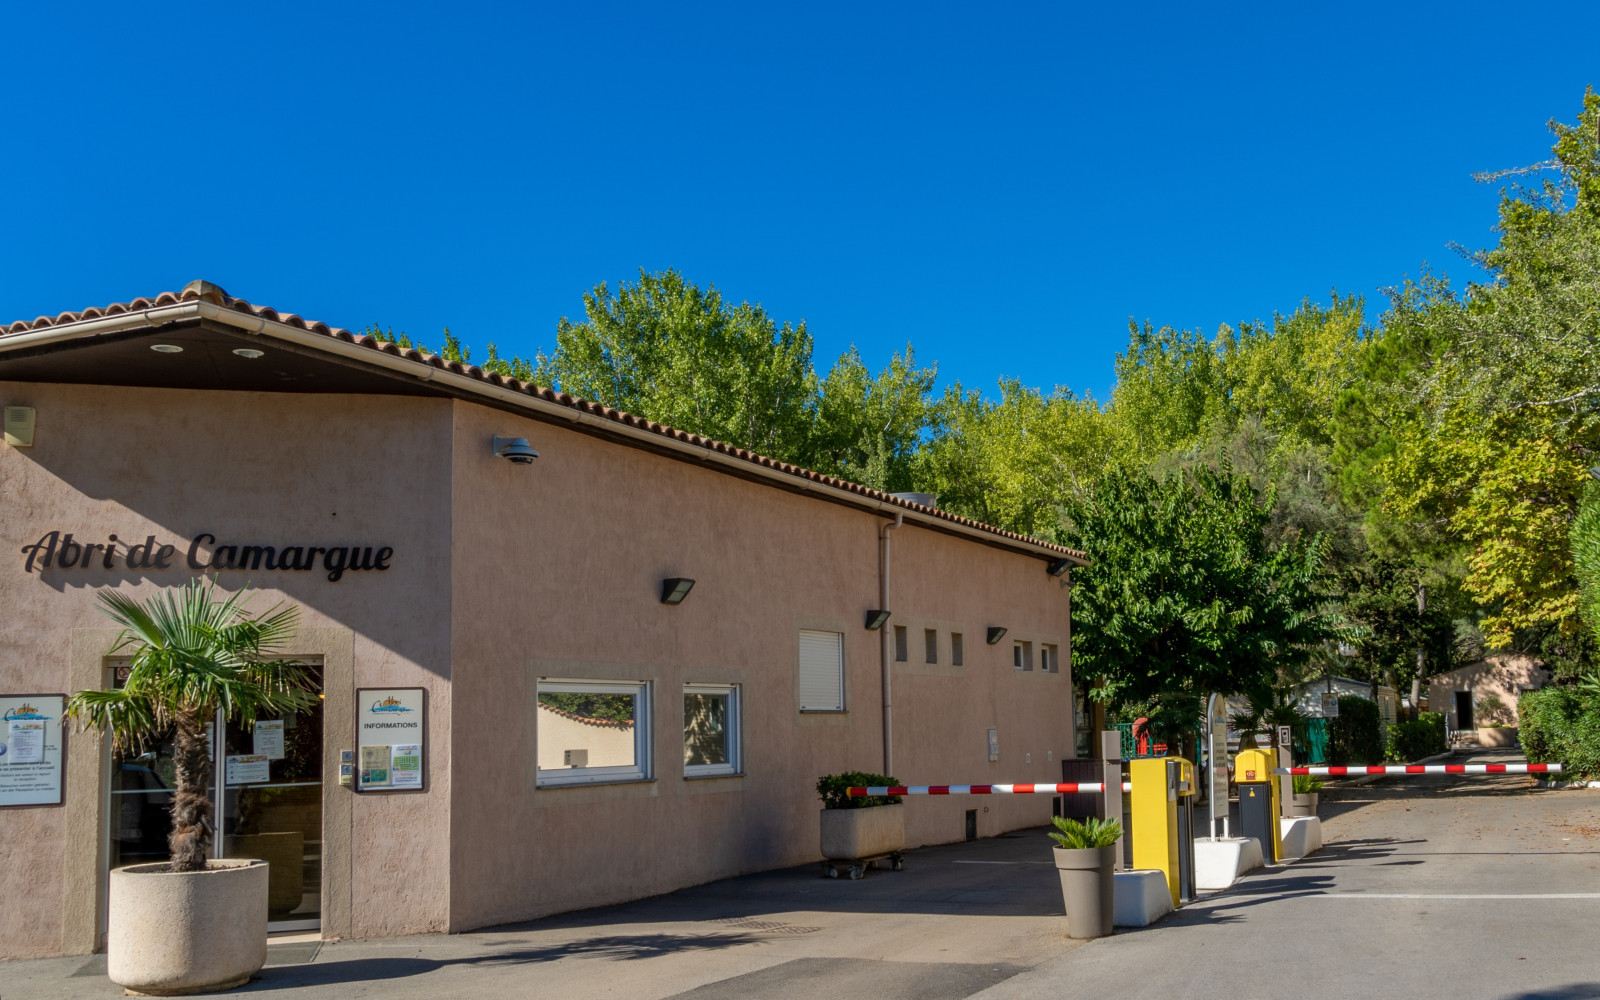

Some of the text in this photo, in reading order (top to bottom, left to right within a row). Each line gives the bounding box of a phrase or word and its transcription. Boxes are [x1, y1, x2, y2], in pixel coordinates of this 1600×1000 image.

[21, 530, 394, 583] Abri de Camargue
